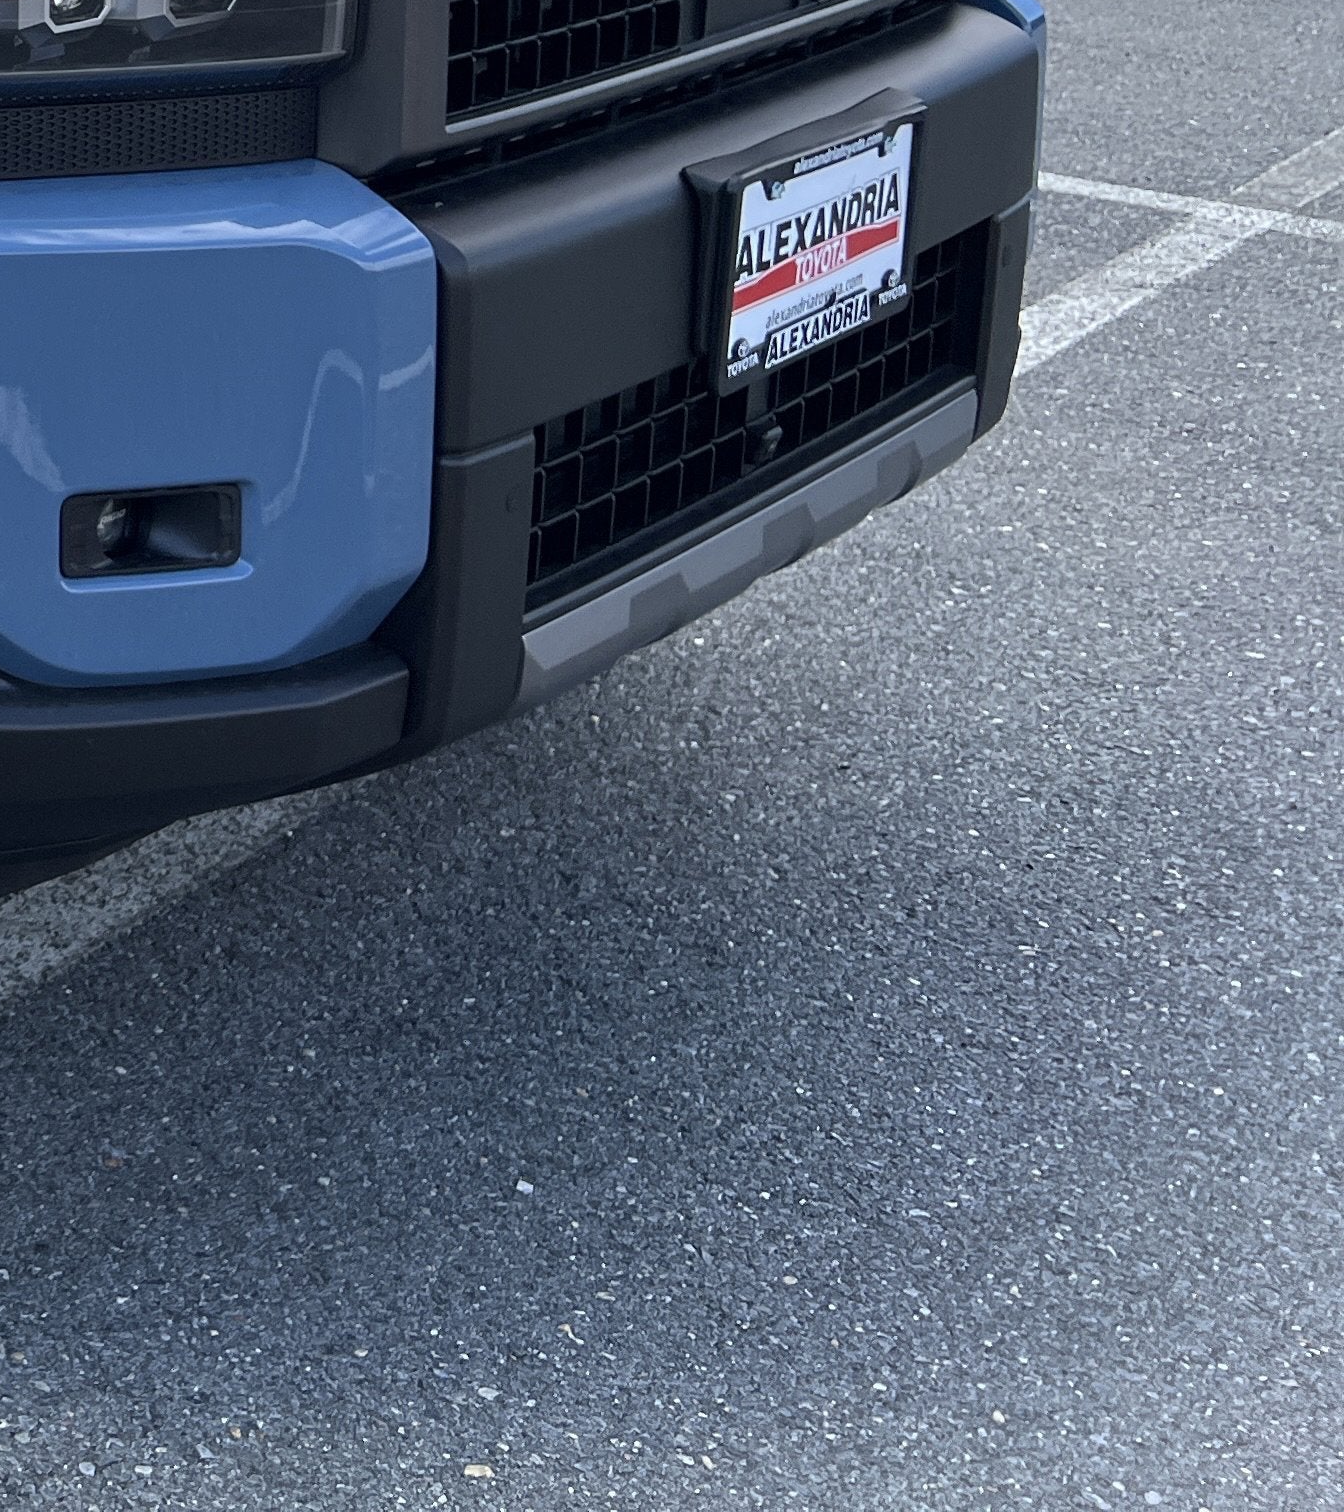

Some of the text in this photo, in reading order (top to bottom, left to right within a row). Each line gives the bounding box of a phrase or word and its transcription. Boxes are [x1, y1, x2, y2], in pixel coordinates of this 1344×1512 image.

[736, 172, 900, 278] ALEXANDRIA
[796, 238, 847, 285] TOYOTA
[768, 297, 870, 363] ALEXANDRIA
